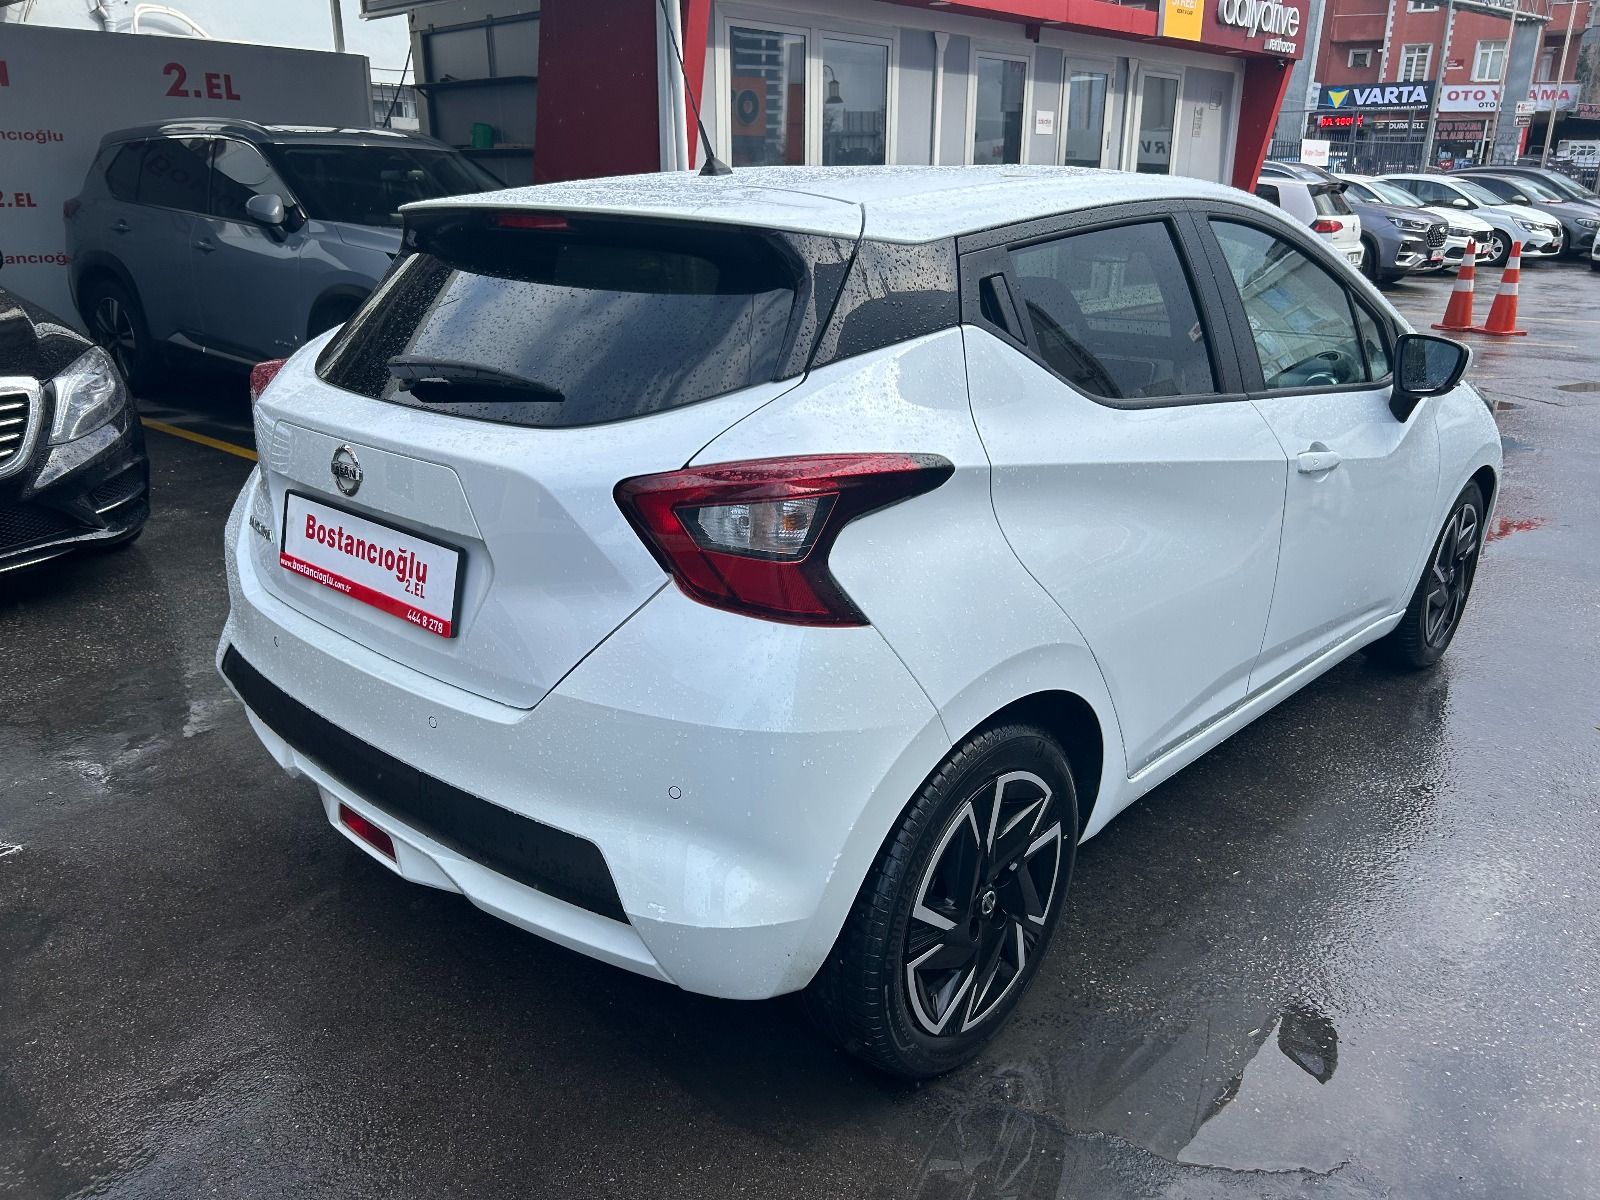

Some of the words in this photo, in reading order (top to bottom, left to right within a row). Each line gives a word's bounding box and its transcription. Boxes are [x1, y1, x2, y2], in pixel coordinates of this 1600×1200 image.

[163, 62, 240, 100] 2.EL
[1353, 86, 1428, 105] VARTA
[1447, 90, 1486, 101] OTO
[1389, 122, 1424, 130] DURAELL
[305, 513, 428, 584] Bostancıoğlu
[405, 579, 425, 599] 2.EL
[407, 609, 421, 624] 444
[422, 616, 427, 627] 8
[429, 618, 443, 634] 278
